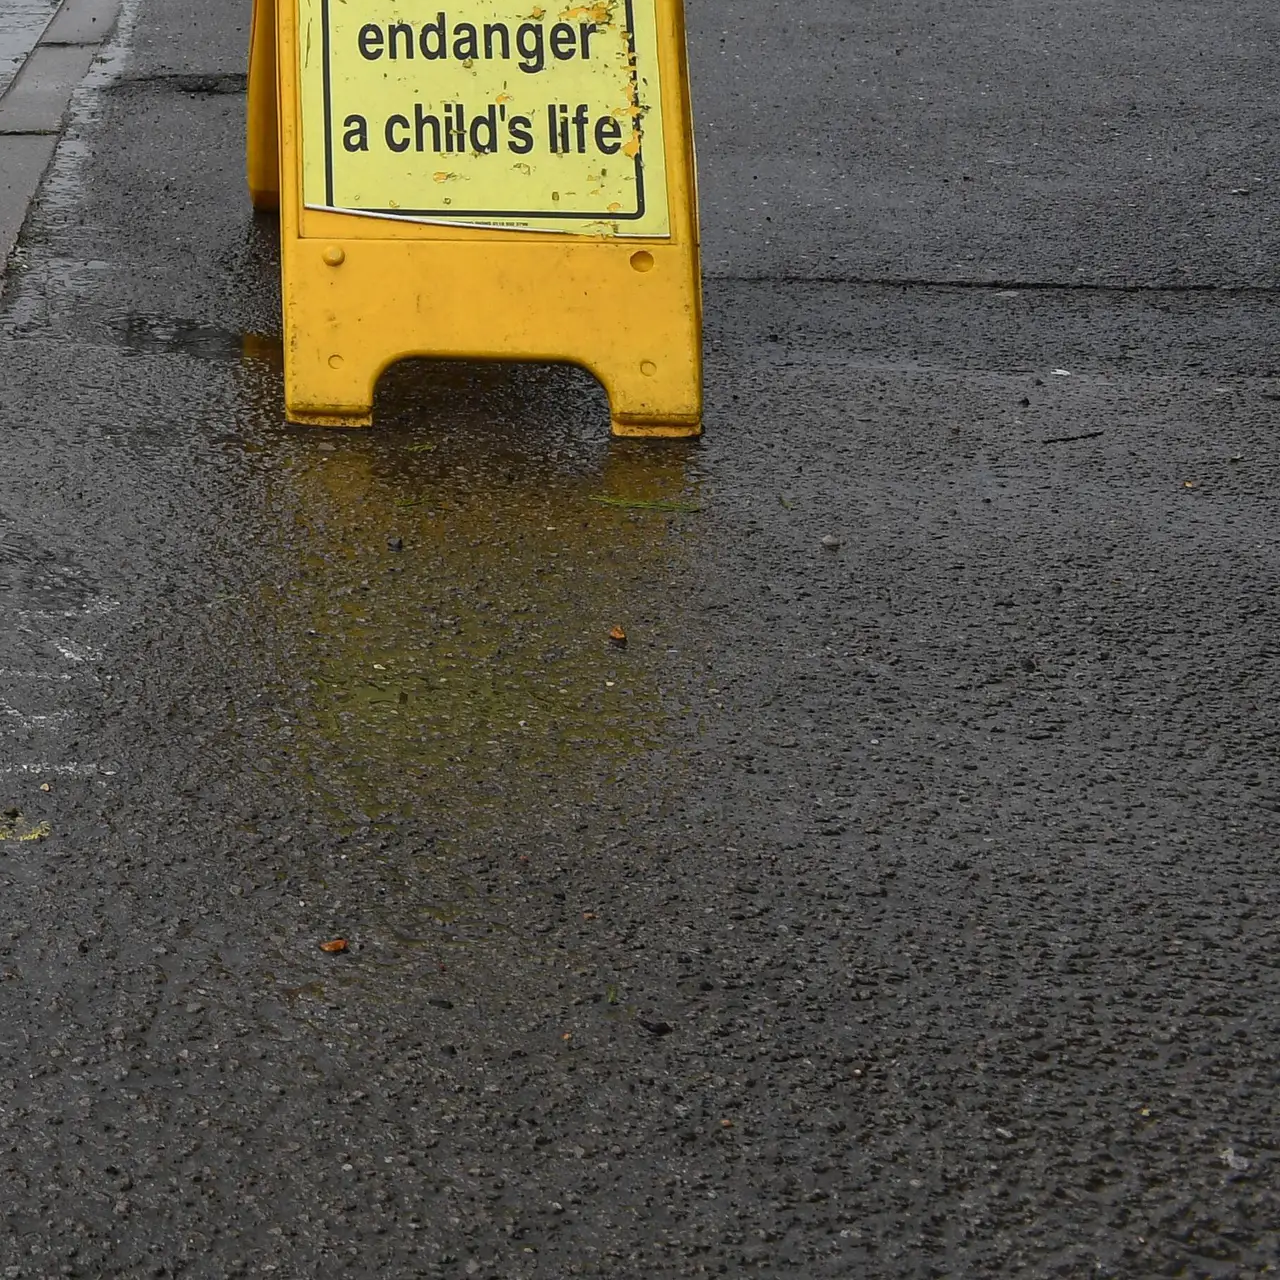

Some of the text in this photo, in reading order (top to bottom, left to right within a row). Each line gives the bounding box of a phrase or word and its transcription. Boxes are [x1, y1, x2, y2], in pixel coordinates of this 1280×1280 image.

[358, 11, 597, 74] endanger
[343, 103, 622, 155] a child's life
